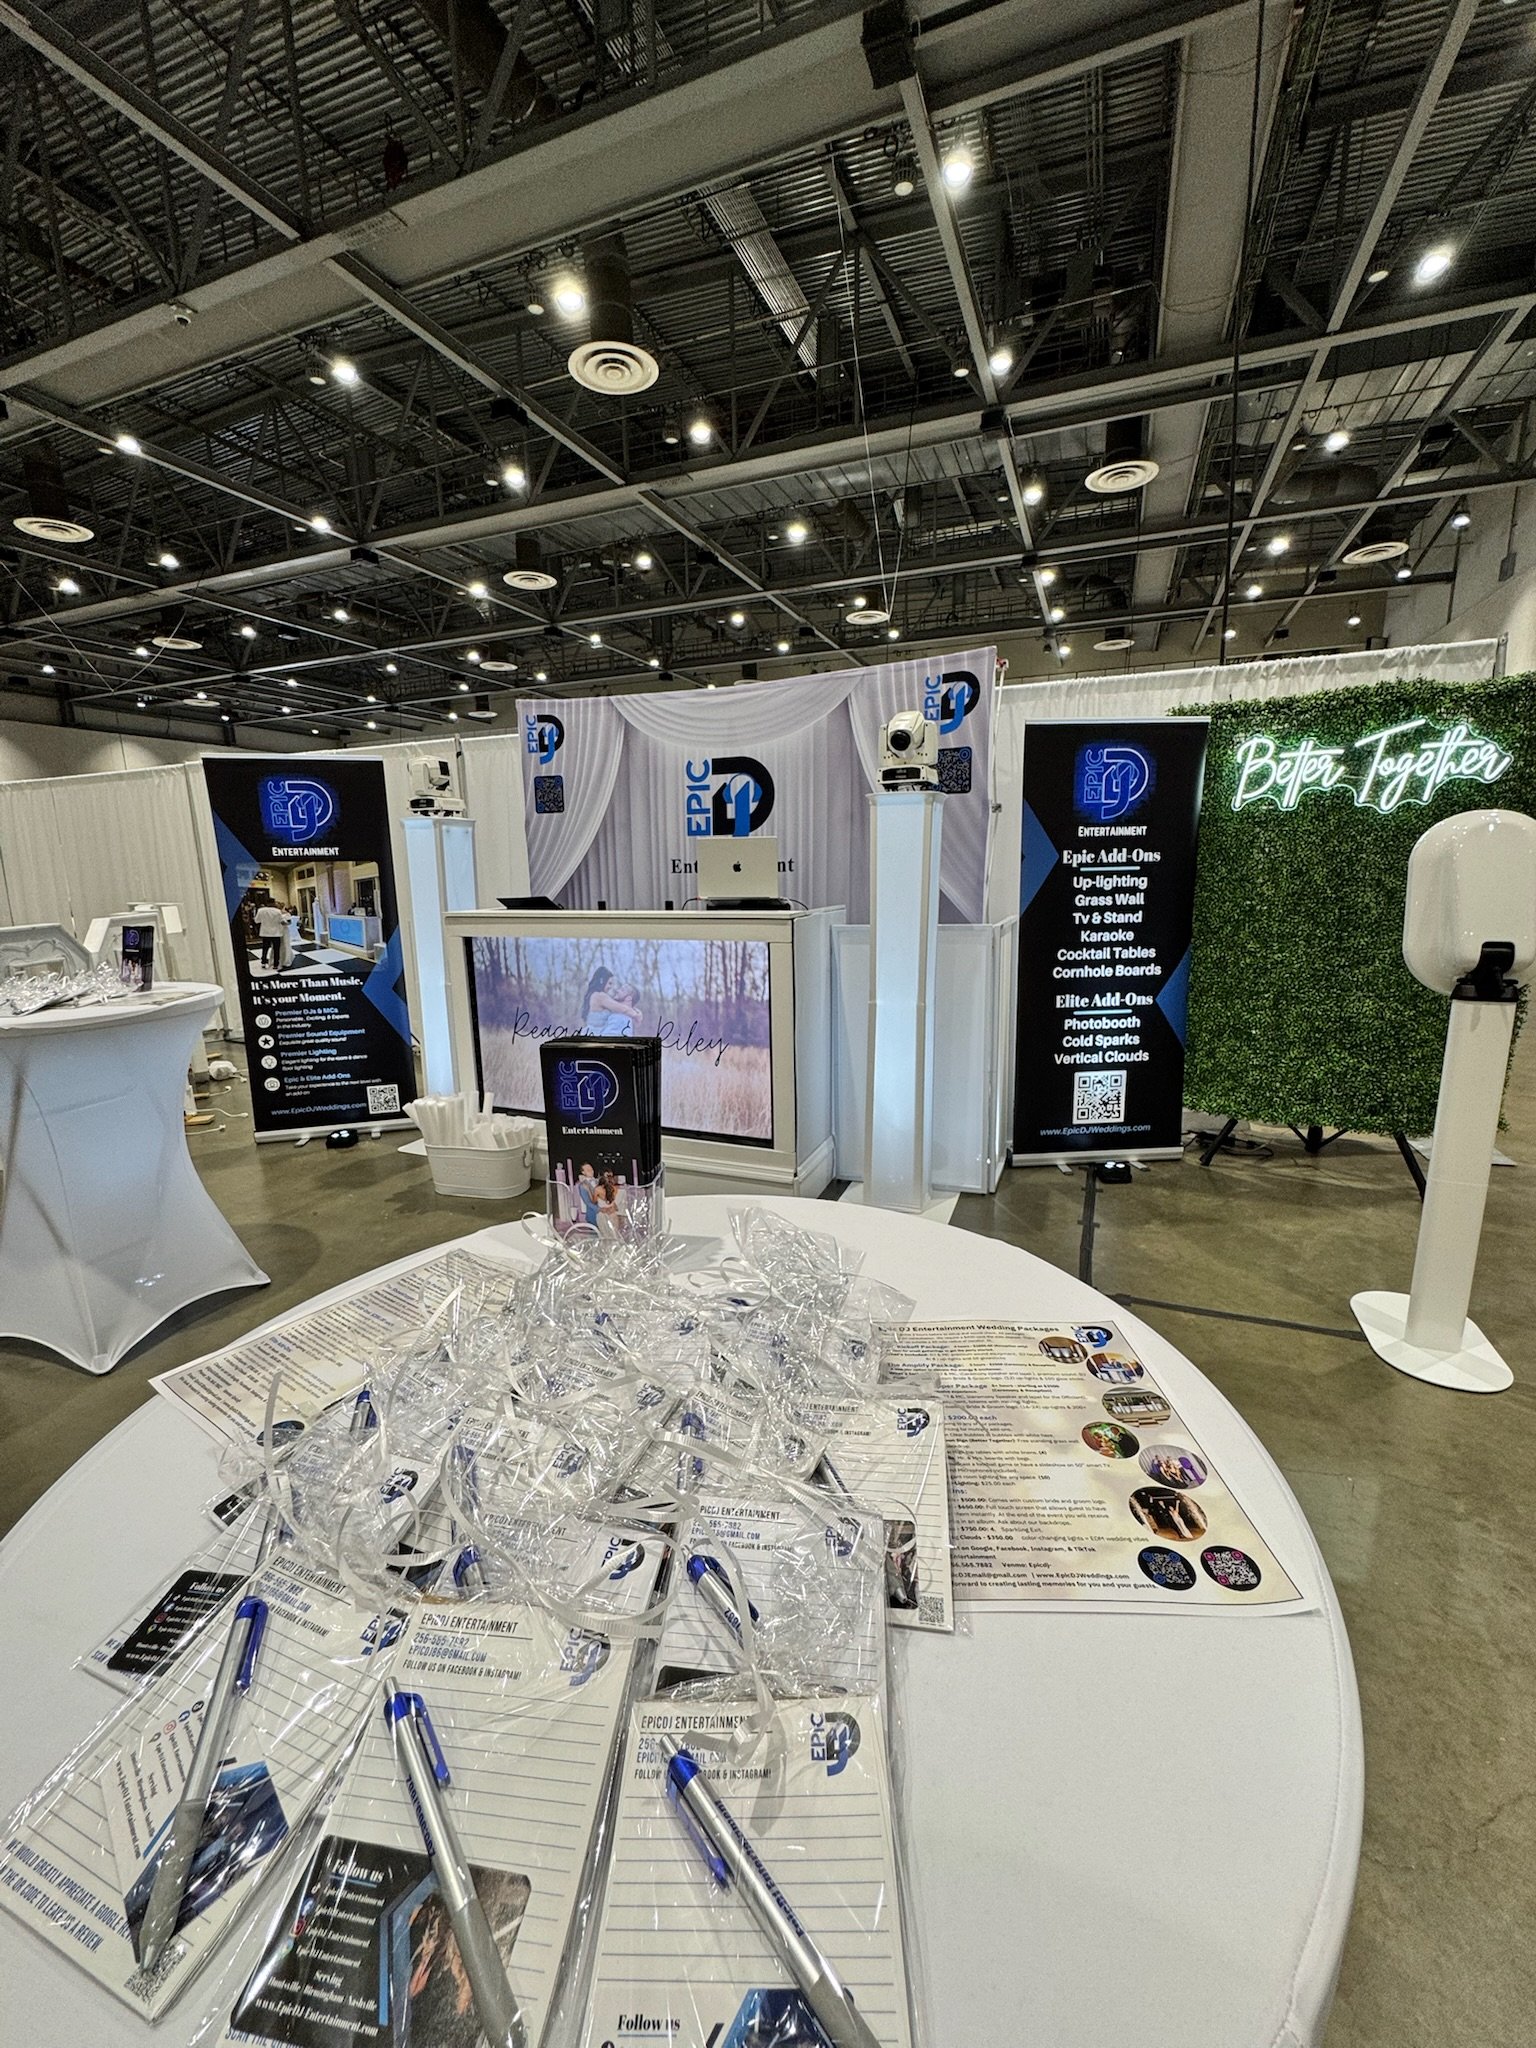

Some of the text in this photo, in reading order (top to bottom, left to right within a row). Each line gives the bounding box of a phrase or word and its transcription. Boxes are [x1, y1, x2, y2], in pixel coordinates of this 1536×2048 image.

[924, 674, 941, 721] EPIC
[527, 714, 537, 754] EPIC
[1232, 719, 1512, 809] Better Together
[1084, 749, 1104, 803] EPIC
[267, 780, 290, 828] EPIC
[686, 758, 712, 837] EPIC
[1062, 848, 1161, 867] Epic Add-Ons
[1072, 875, 1148, 891] Up-lighting
[1074, 892, 1145, 906] Grass Wall
[1072, 910, 1143, 925] Tv & Stand
[1080, 929, 1134, 942] Karaoke
[1057, 946, 1156, 960] Cocktail Tables
[1053, 963, 1162, 978] Cornhole Boards
[251, 976, 364, 990] It's More Than Music.
[253, 992, 346, 1006] It's your Moment.
[1055, 992, 1154, 1008] Elite Add-Ons
[1064, 1016, 1141, 1030] Photobooth
[329, 1028, 365, 1037] Equipment
[1062, 1033, 1140, 1048] Cold Sparks
[655, 1015, 730, 1067] Riley
[1054, 1050, 1149, 1064] Vertical Clouds
[559, 1061, 578, 1111] EPIC
[562, 1126, 624, 1136] Entertainment
[976, 1324, 1016, 1332] Wedding
[450, 1616, 519, 1634] ENTERTAINMENT
[402, 1658, 428, 1671] FOLLOW
[427, 1662, 437, 1672] US
[436, 1663, 447, 1673] ON
[446, 1664, 478, 1677] FACEBOOK
[641, 1715, 672, 1729] EPICDJ
[810, 1711, 826, 1761] EPIC
[634, 1768, 662, 1780] FOLLOW
[729, 1768, 772, 1780] INSTAGRAM!
[332, 1858, 385, 1884] Follow us
[33, 1858, 64, 1884] GREATLY
[55, 1875, 97, 1910] APPRECIATE
[88, 1900, 101, 1914] A
[95, 1903, 125, 1931] GOOGLE
[313, 1969, 344, 1989] Serving
[617, 2013, 681, 2031] Follow us
